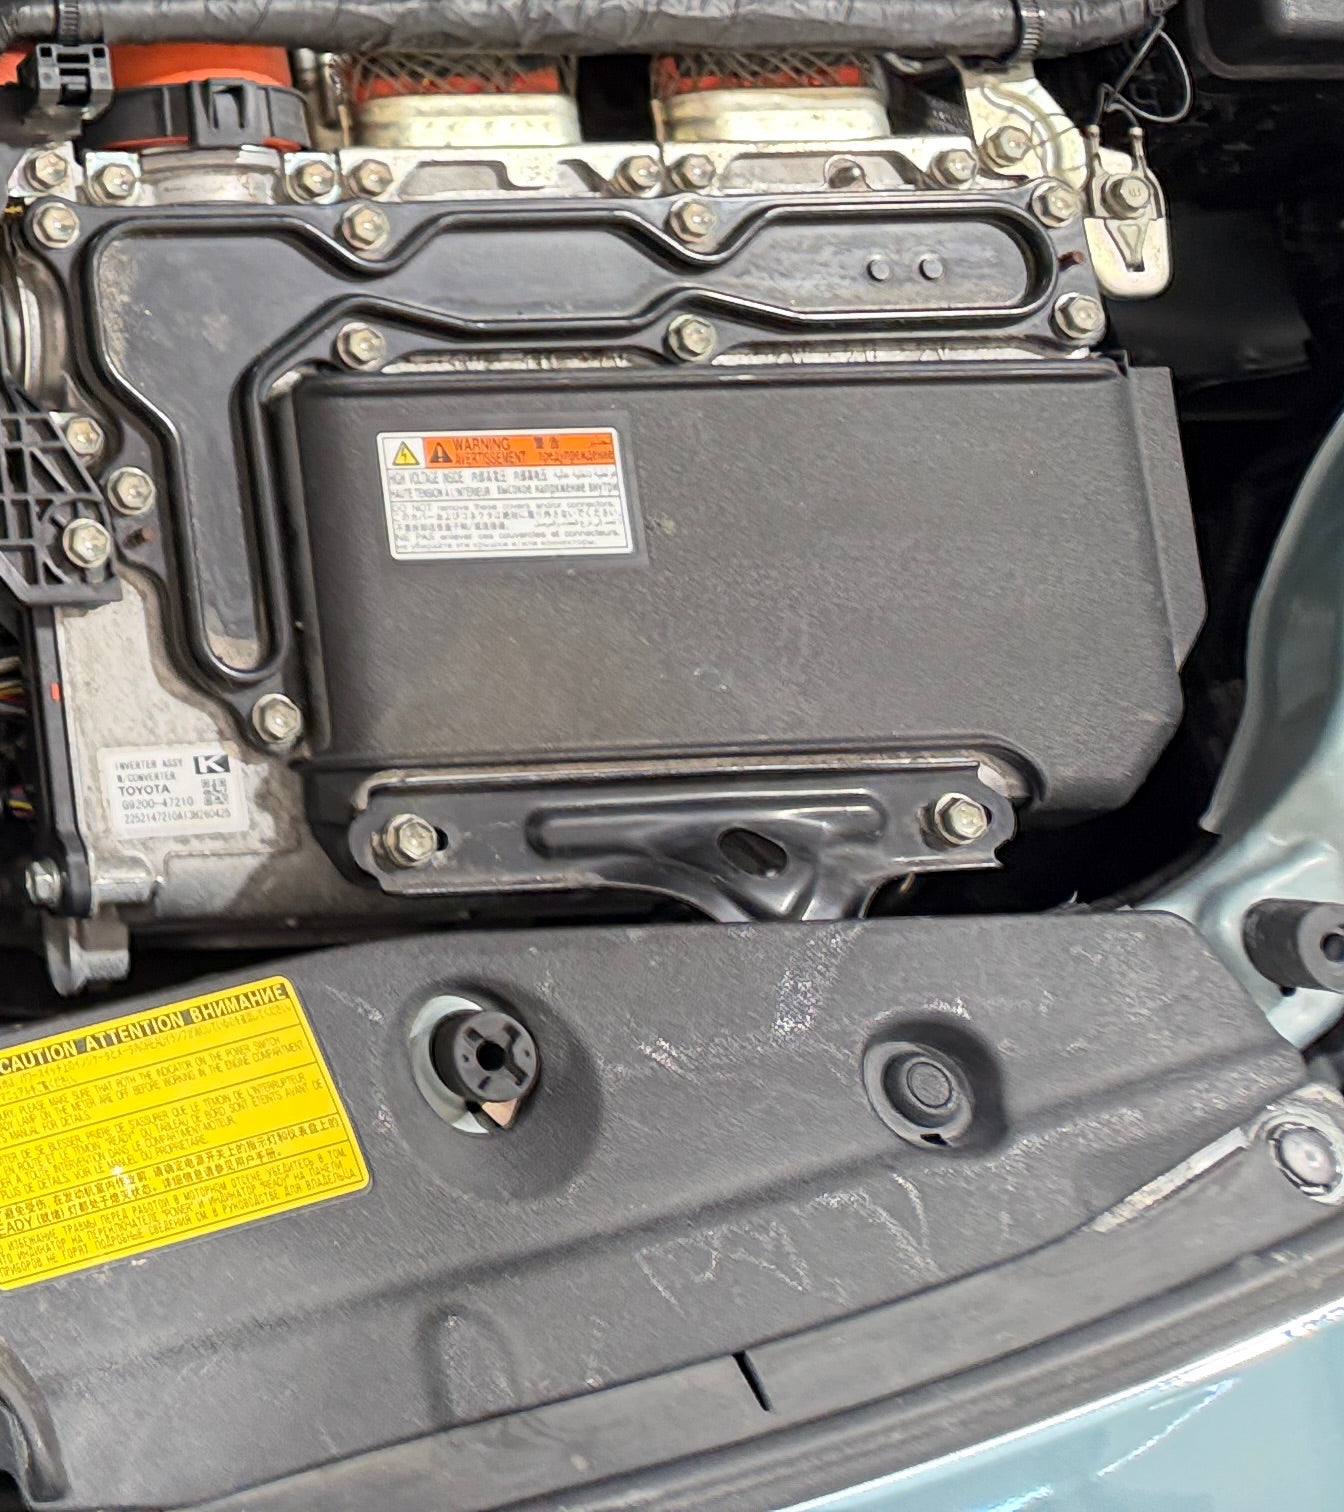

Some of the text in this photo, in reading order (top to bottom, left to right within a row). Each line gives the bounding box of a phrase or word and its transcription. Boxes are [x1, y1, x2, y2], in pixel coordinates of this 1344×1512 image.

[453, 437, 510, 450] WARNING
[114, 757, 183, 771] INVERTER ASSY
[117, 783, 170, 796] TOYOTA
[188, 984, 287, 1023] ВНИМАНИЕ
[82, 1011, 185, 1051] ATTENTION
[16, 1113, 37, 1127] LAMP
[39, 1109, 51, 1120] ON
[54, 1104, 70, 1116] THE
[70, 1097, 96, 1112] METER
[97, 1092, 113, 1104] ARE
[114, 1087, 129, 1100] OFF
[131, 1079, 161, 1095] BEFORE
[208, 1062, 223, 1074] THE
[18, 1099, 45, 1114] PLEASE
[71, 1087, 91, 1100] SURE
[93, 1081, 113, 1093] THAT
[115, 1074, 136, 1088] BOTH
[139, 1070, 152, 1081] THE
[194, 1055, 207, 1066] ON
[208, 1051, 223, 1062] THE
[224, 1043, 251, 1058] POWER
[2, 1163, 15, 1175] EN
[16, 1155, 43, 1172] ROUTE
[45, 1152, 56, 1164] ET
[58, 1148, 69, 1160] LE
[138, 1125, 152, 1138] DU
[154, 1115, 189, 1134] TABLEAU
[189, 1111, 202, 1124] DE
[203, 1105, 226, 1120] BORD
[227, 1098, 249, 1113] SONT
[283, 1082, 310, 1098] AVANT
[310, 1078, 323, 1090] DE
[19, 1147, 31, 1159] DE
[33, 1144, 45, 1155] SE
[113, 1122, 125, 1133] DE
[170, 1104, 187, 1117] QUE
[189, 1101, 200, 1112] LE
[232, 1089, 244, 1100] DE
[41, 1119, 58, 1131] FOR
[0, 1185, 21, 1200] PLUS
[22, 1181, 35, 1193] DE
[72, 1166, 92, 1180] VOIR
[93, 1162, 105, 1174] LE
[139, 1149, 153, 1161] DU
[24, 1140, 142, 1181] TOUTE INTERVENTION DANS LE
[70, 1233, 83, 1245] НА
[292, 1170, 306, 1181] НА
